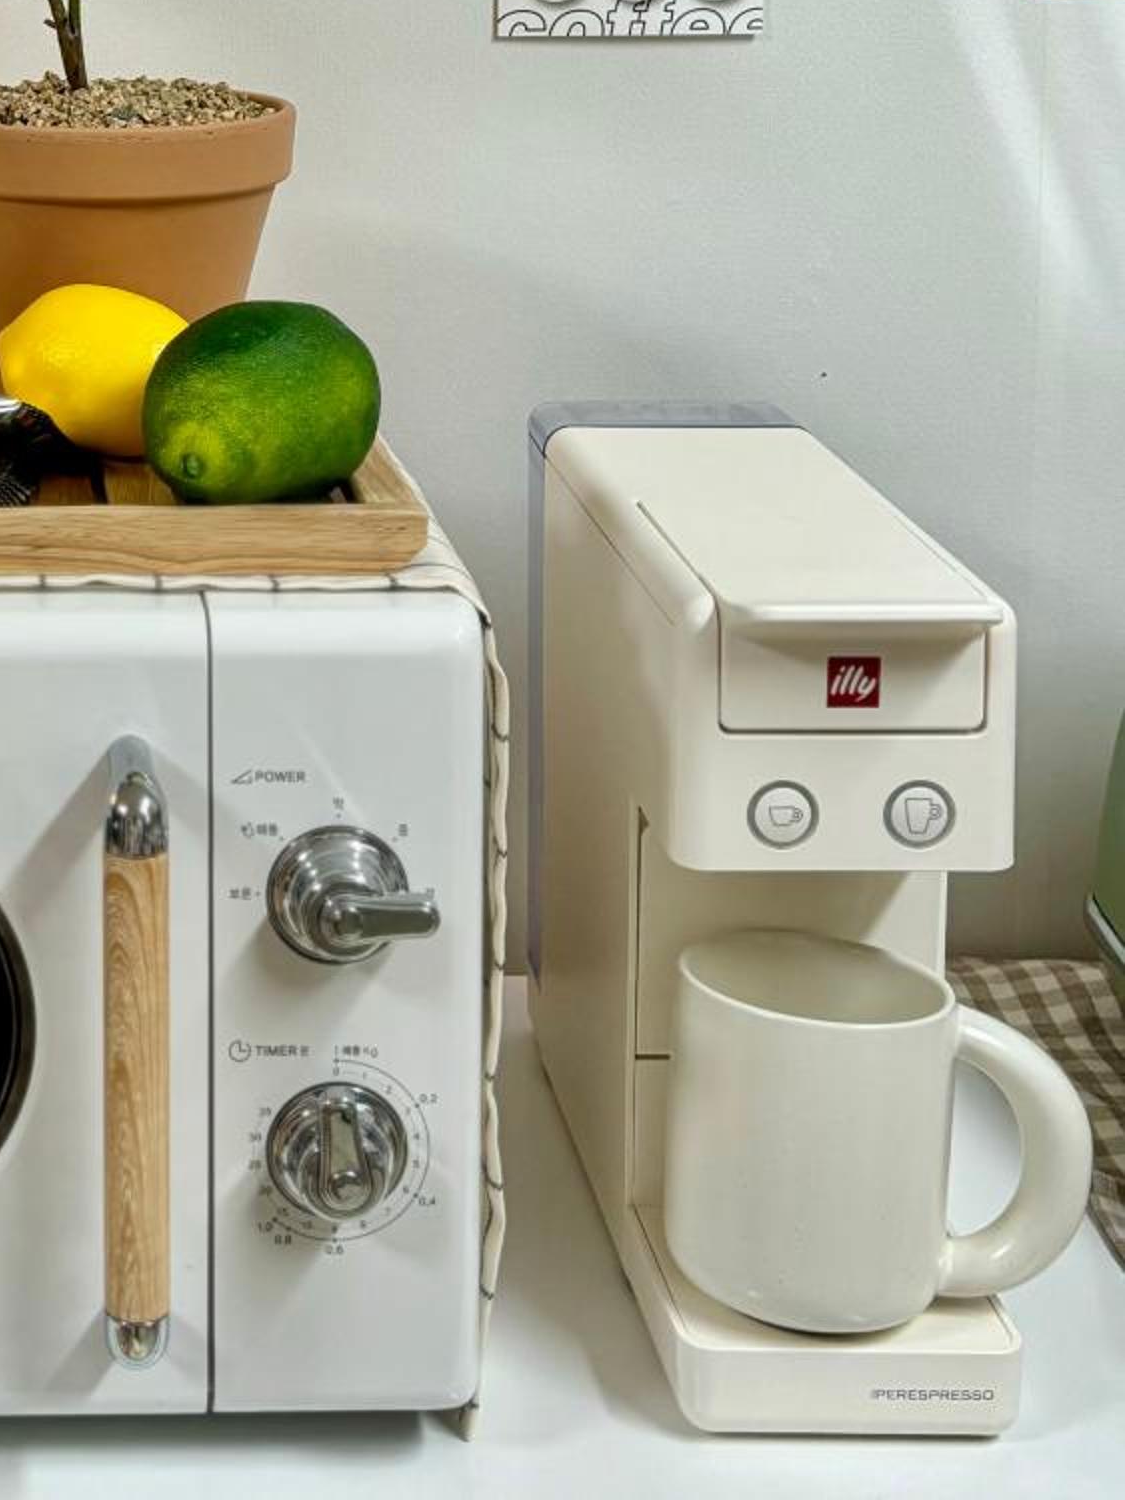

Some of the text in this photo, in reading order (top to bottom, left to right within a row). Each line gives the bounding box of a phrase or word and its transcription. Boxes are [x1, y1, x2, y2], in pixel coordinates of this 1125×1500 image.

[830, 665, 876, 702] illy
[255, 771, 306, 784] POWER
[255, 1045, 296, 1057] TIMER
[418, 1195, 436, 1206] 0.4
